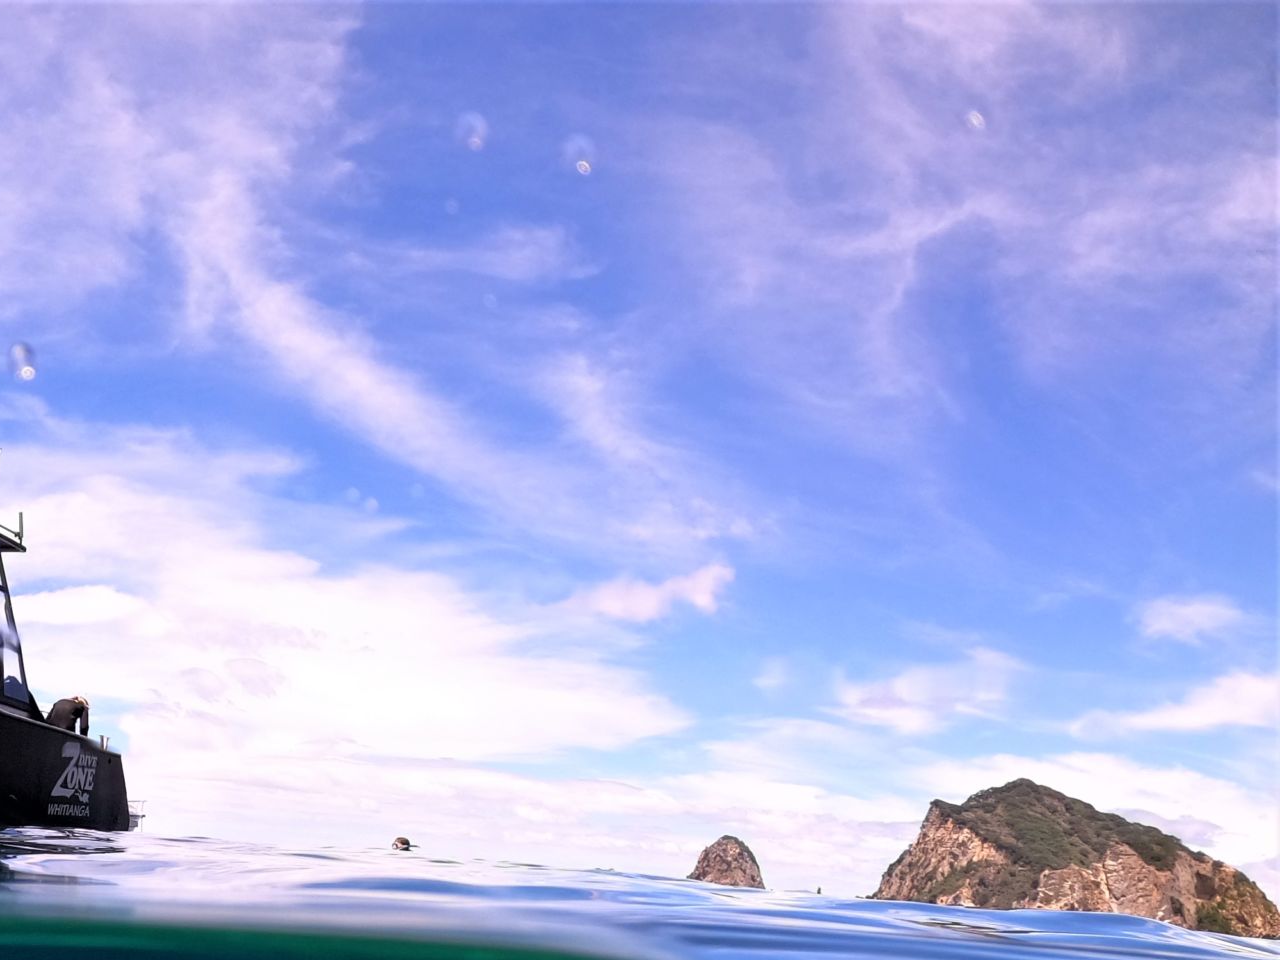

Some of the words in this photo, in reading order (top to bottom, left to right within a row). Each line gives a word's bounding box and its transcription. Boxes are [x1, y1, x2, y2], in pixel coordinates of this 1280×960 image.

[78, 753, 98, 767] DIVE
[50, 741, 96, 799] ZONE
[47, 803, 90, 817] WHITIANGA
